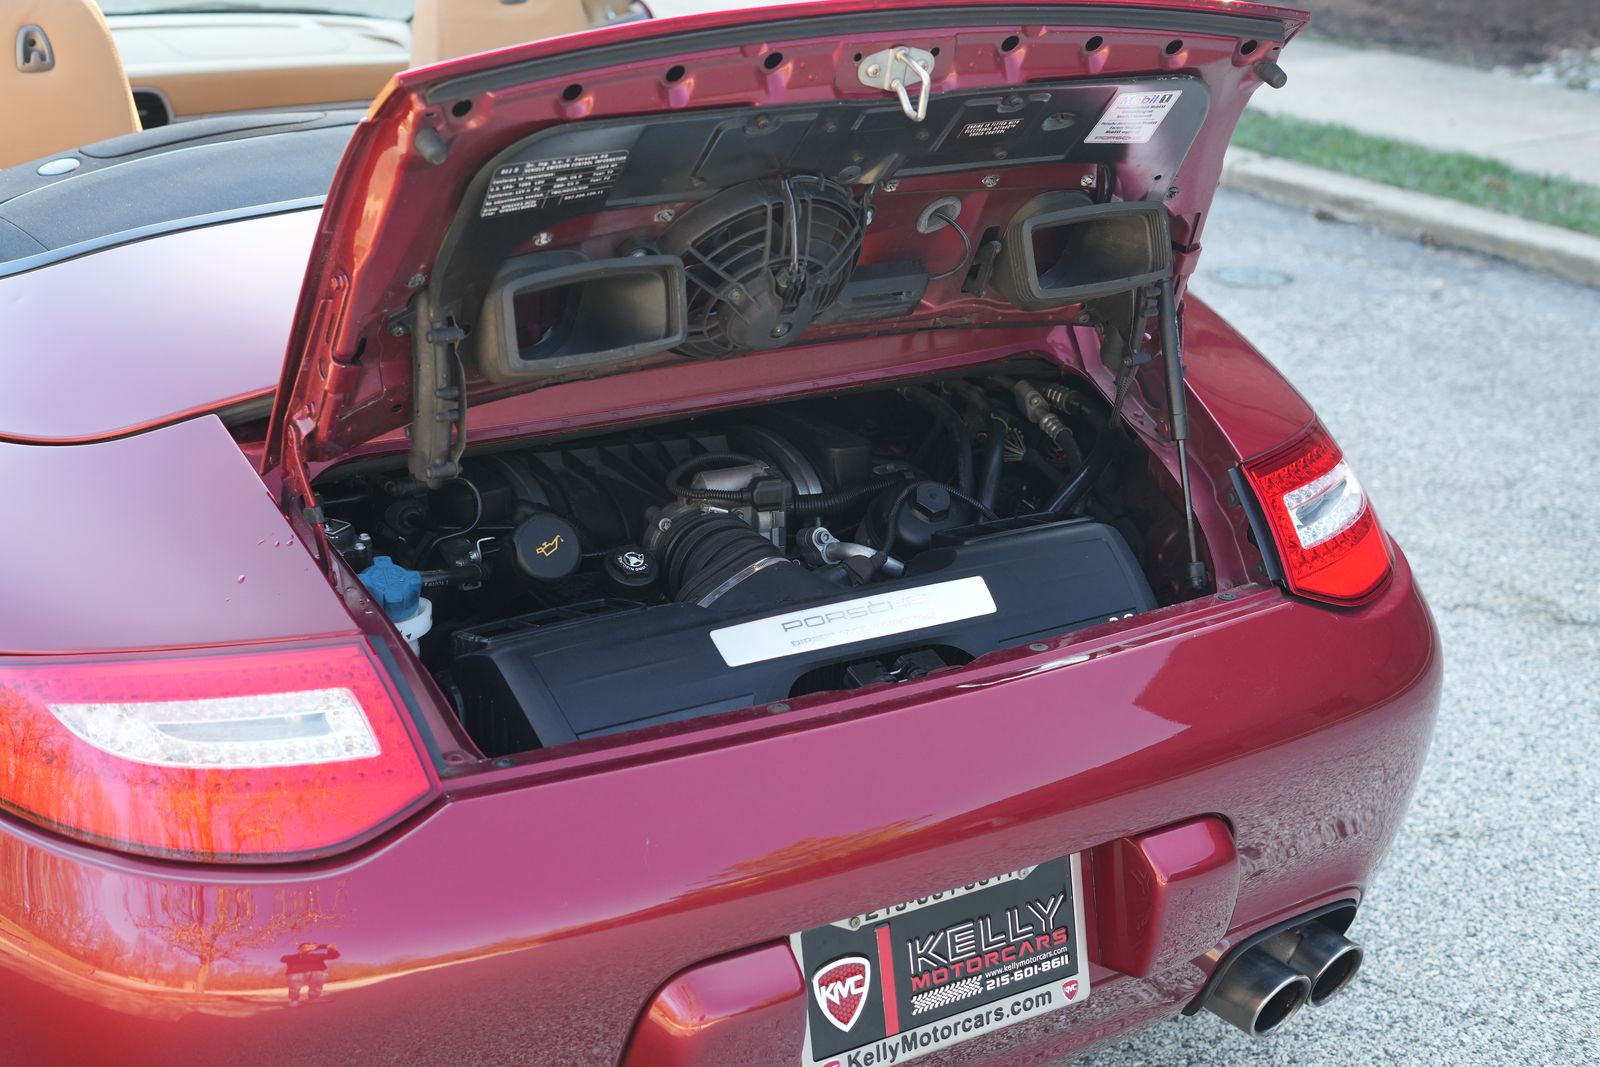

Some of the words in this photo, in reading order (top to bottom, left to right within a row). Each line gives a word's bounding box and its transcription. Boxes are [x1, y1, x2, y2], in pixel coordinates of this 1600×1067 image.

[907, 893, 1065, 976] KELLY
[911, 927, 1068, 992] MOTORCARS
[985, 946, 1068, 979] www.kellymotorcars.com
[986, 954, 1069, 991] 215-601-8611
[847, 990, 1053, 1067] KellyMotorcars.com
